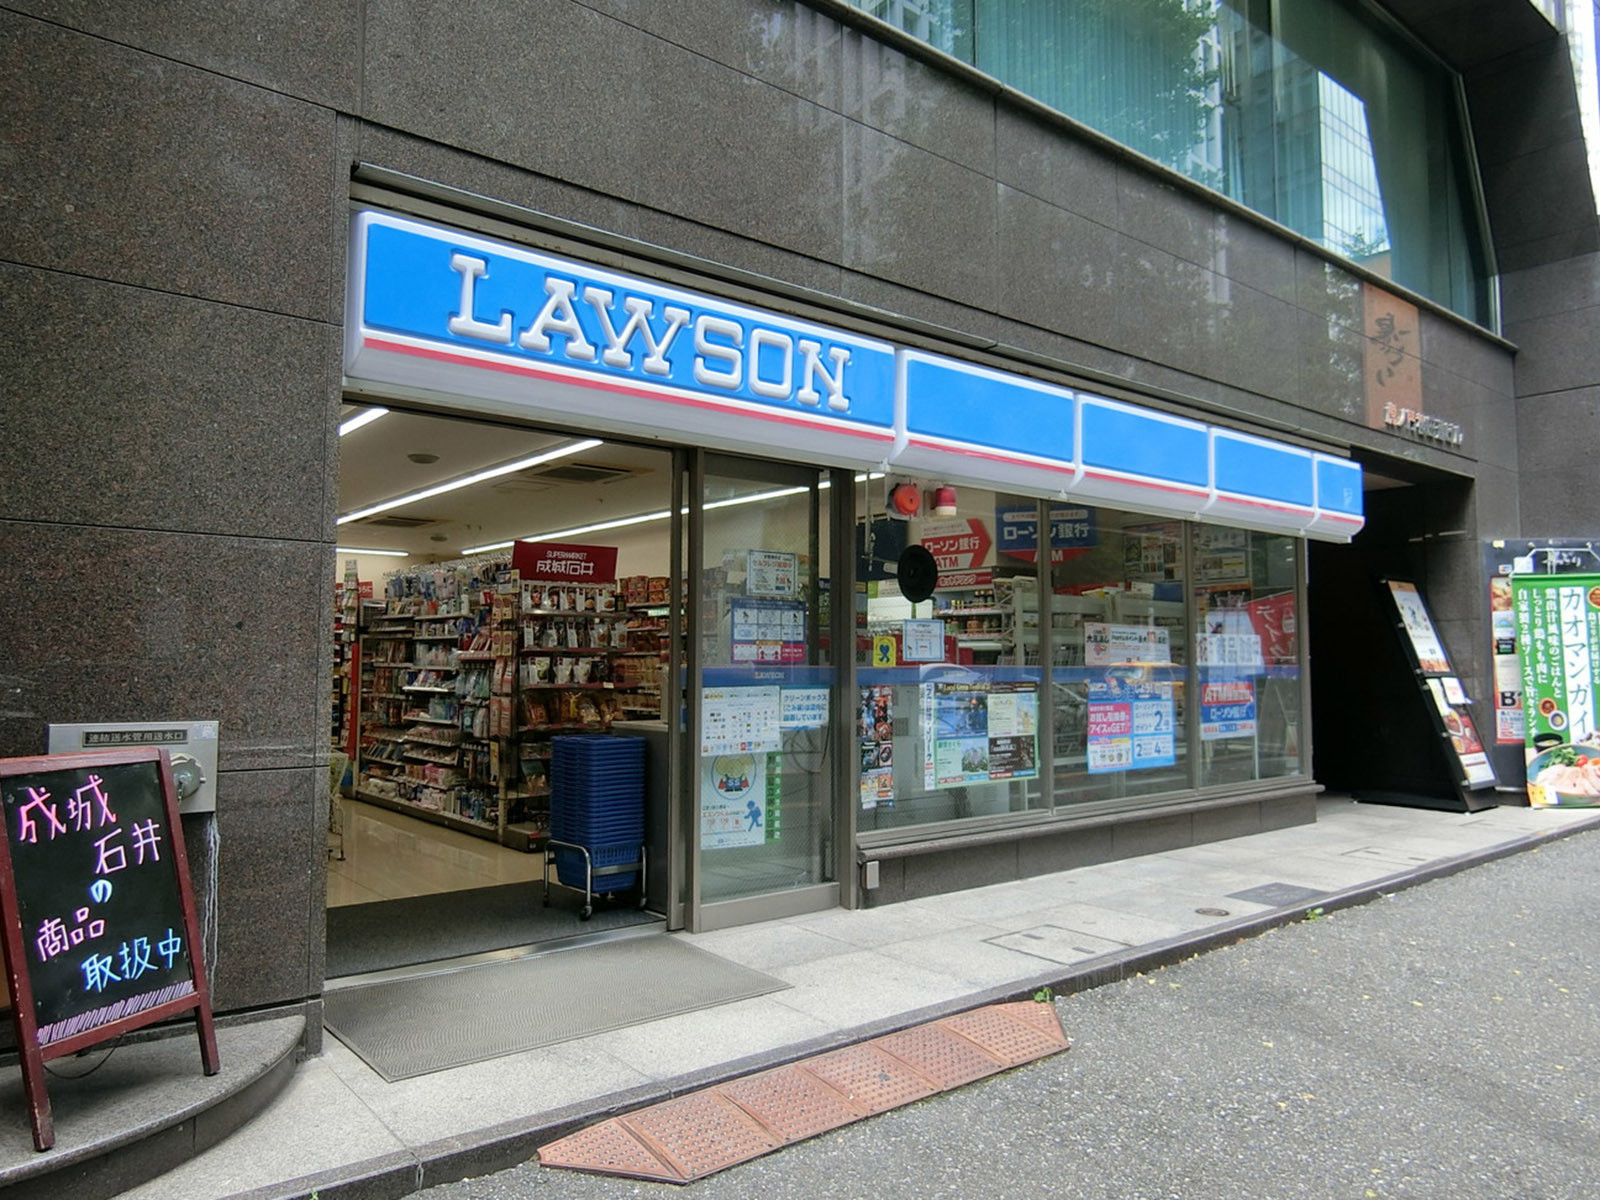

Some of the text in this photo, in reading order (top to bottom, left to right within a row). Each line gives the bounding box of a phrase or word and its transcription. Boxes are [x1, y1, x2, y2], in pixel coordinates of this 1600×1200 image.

[447, 252, 853, 413] LAWSON
[546, 550, 587, 560] SUPERMARKET
[924, 536, 980, 553] ローソン銀行
[935, 555, 959, 569] ATM
[536, 559, 595, 576] 成城石井
[1562, 588, 1589, 734] カオマンガイ
[88, 731, 184, 743] 連結送水管用送水口
[19, 774, 118, 844] 成城
[95, 819, 161, 874] 石井
[90, 879, 113, 903] の
[37, 906, 106, 962] 商品
[81, 928, 184, 992] 取扱中
